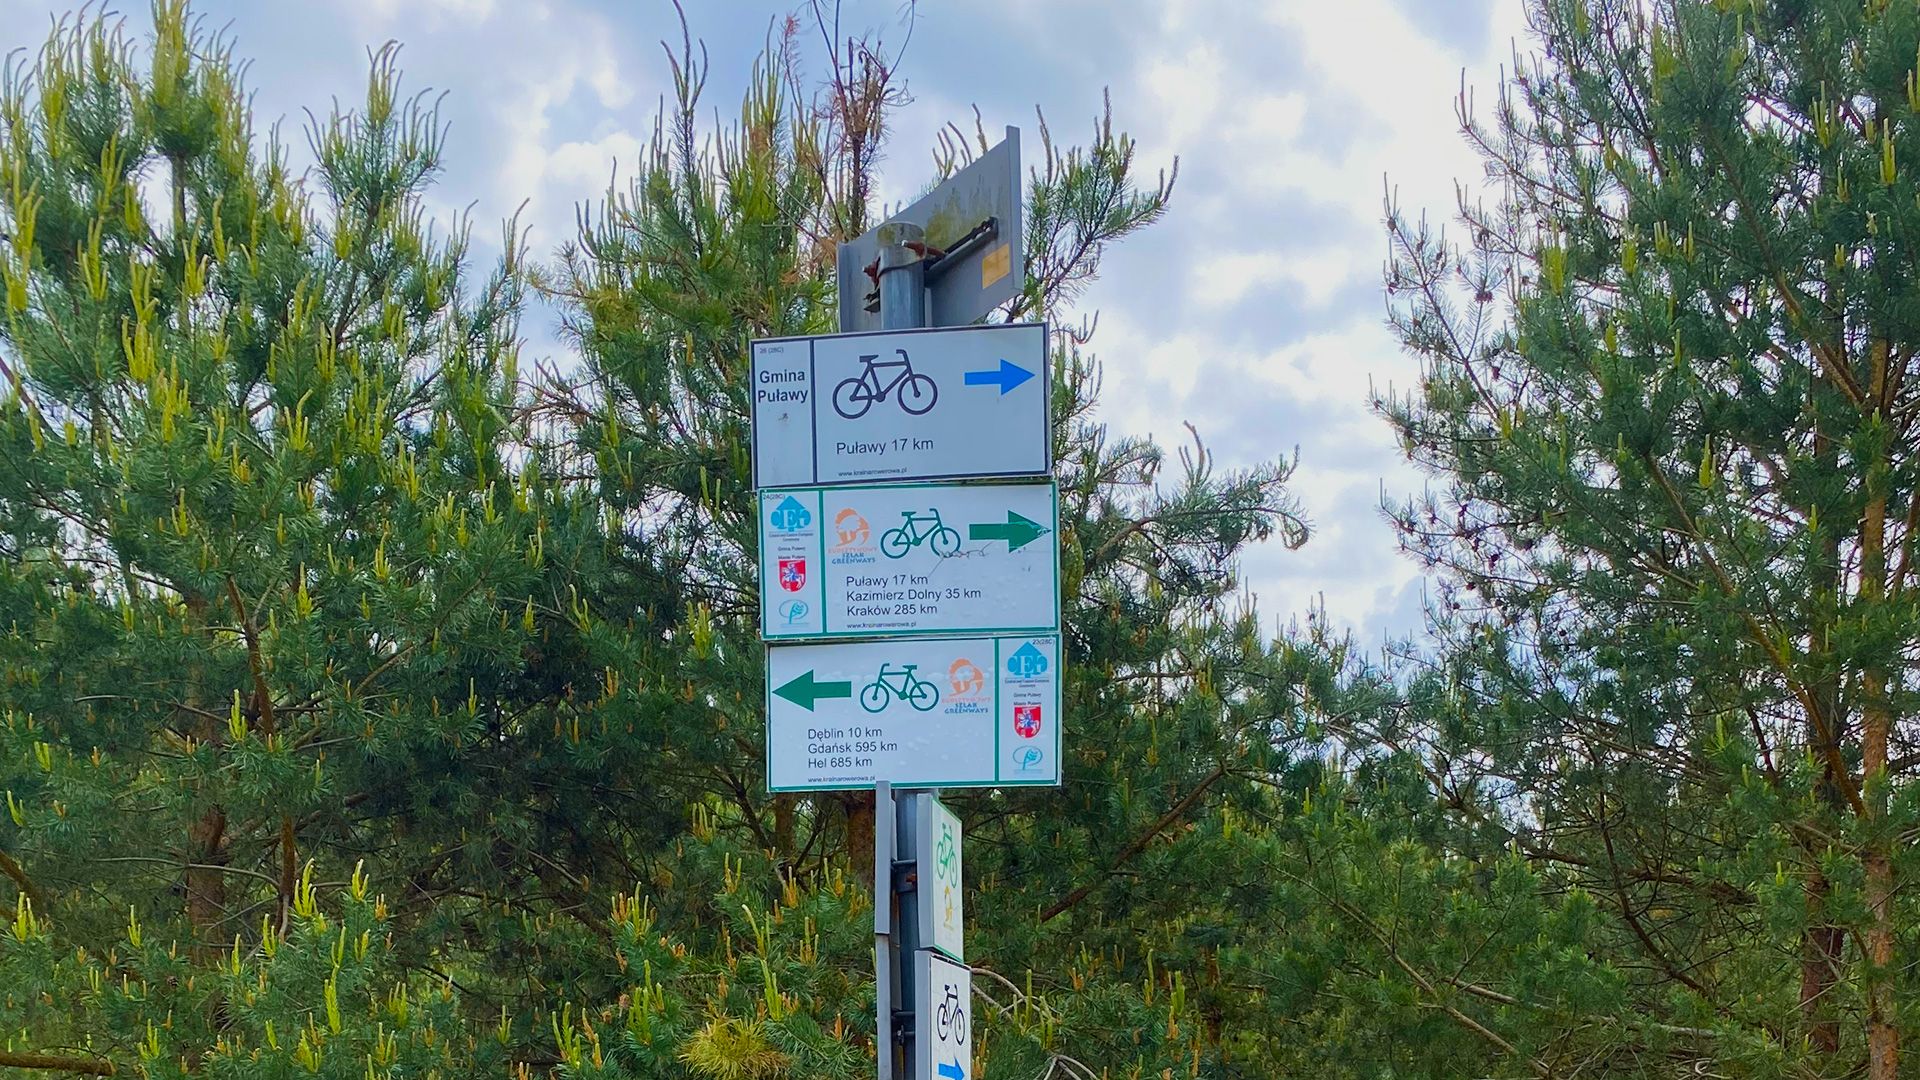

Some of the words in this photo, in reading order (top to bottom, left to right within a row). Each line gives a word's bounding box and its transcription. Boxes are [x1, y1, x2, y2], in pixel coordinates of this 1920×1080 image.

[760, 369, 805, 384] Gmina
[758, 389, 808, 404] Puławy
[836, 442, 887, 455] Puławy
[892, 438, 908, 451] 17
[913, 438, 934, 450] km
[838, 467, 908, 477] www.krainarowerowa.pl
[846, 575, 889, 588] Puławy
[893, 574, 906, 585] 17
[910, 574, 929, 585] km
[846, 590, 904, 602] Kazimierz
[908, 588, 942, 602] Dolny
[945, 588, 960, 599] 35
[963, 588, 981, 598] km
[847, 604, 891, 616] Kraków
[894, 604, 917, 615] 285
[920, 604, 938, 614] km
[808, 728, 844, 742] Dęblin
[848, 727, 862, 738] 10
[865, 727, 882, 738] km
[808, 742, 852, 754] Gdańsk
[855, 741, 877, 752] 595
[880, 741, 898, 751] km
[808, 758, 827, 768] Hel
[830, 757, 852, 768] 685
[855, 757, 873, 767] km
